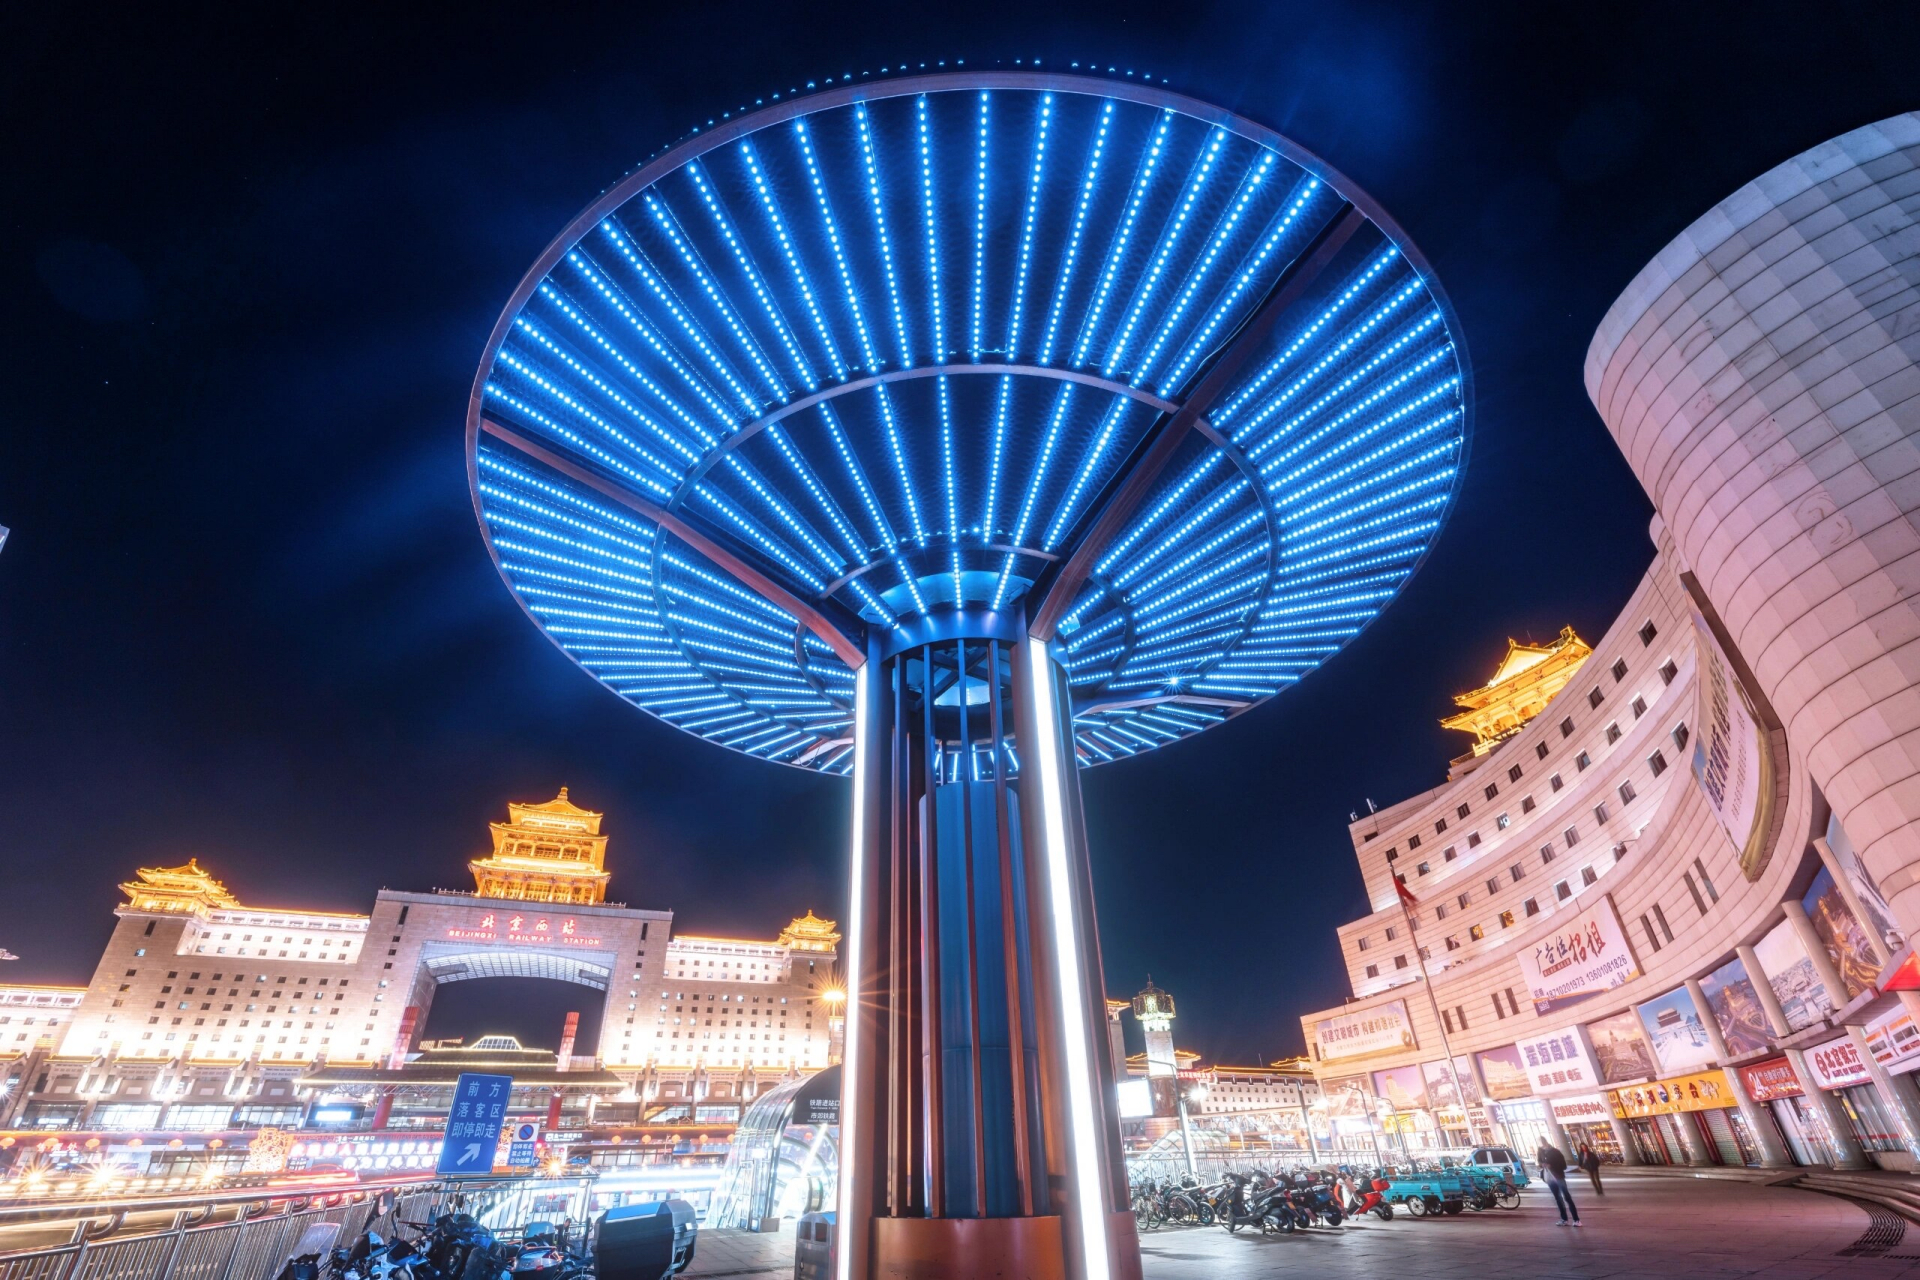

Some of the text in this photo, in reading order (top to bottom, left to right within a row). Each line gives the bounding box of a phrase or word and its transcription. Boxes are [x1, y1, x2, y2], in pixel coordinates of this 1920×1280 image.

[480, 914, 575, 935] 北京西站
[449, 929, 600, 945] BEIJINGXI RAILWAY STATION
[1321, 1024, 1360, 1044] 创建文明城市
[1824, 1043, 1861, 1069] 北京银行
[468, 1081, 501, 1098] 前方
[457, 1101, 501, 1118] 落客区
[451, 1121, 496, 1138] 即停即走
